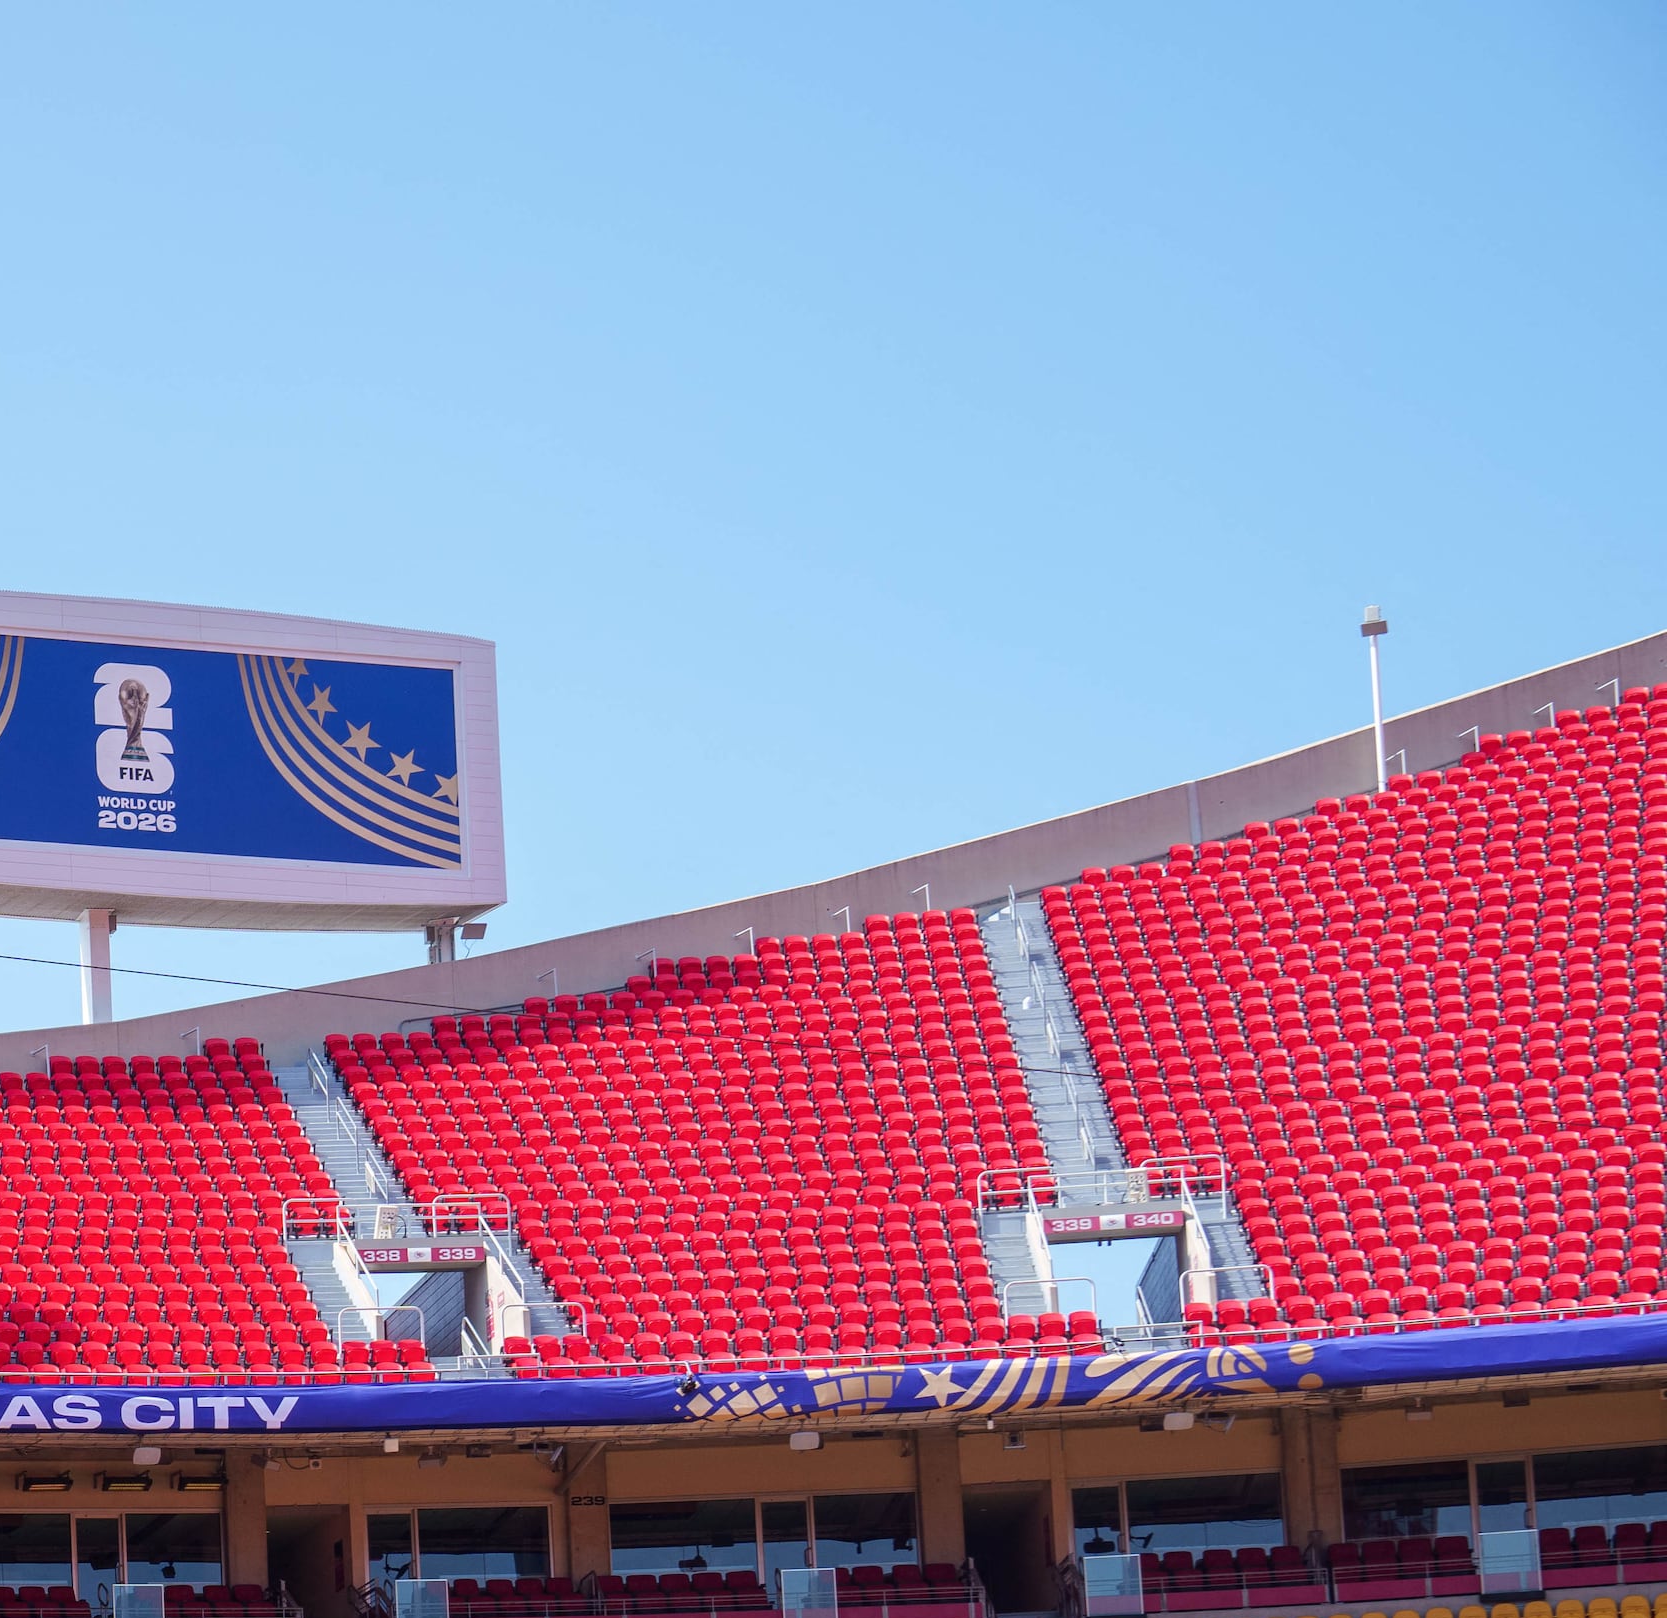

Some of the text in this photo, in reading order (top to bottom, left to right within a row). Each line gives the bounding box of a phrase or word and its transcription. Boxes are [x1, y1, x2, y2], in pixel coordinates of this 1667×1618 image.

[119, 766, 154, 782] FIFA
[97, 795, 177, 812] WORLD CUP
[97, 810, 178, 833] 2026
[1051, 1218, 1092, 1232] 339
[1133, 1212, 1175, 1227] 340
[363, 1249, 401, 1263] 338
[438, 1246, 477, 1261] 339
[121, 1396, 299, 1429] CITY
[570, 1496, 606, 1506] 239
